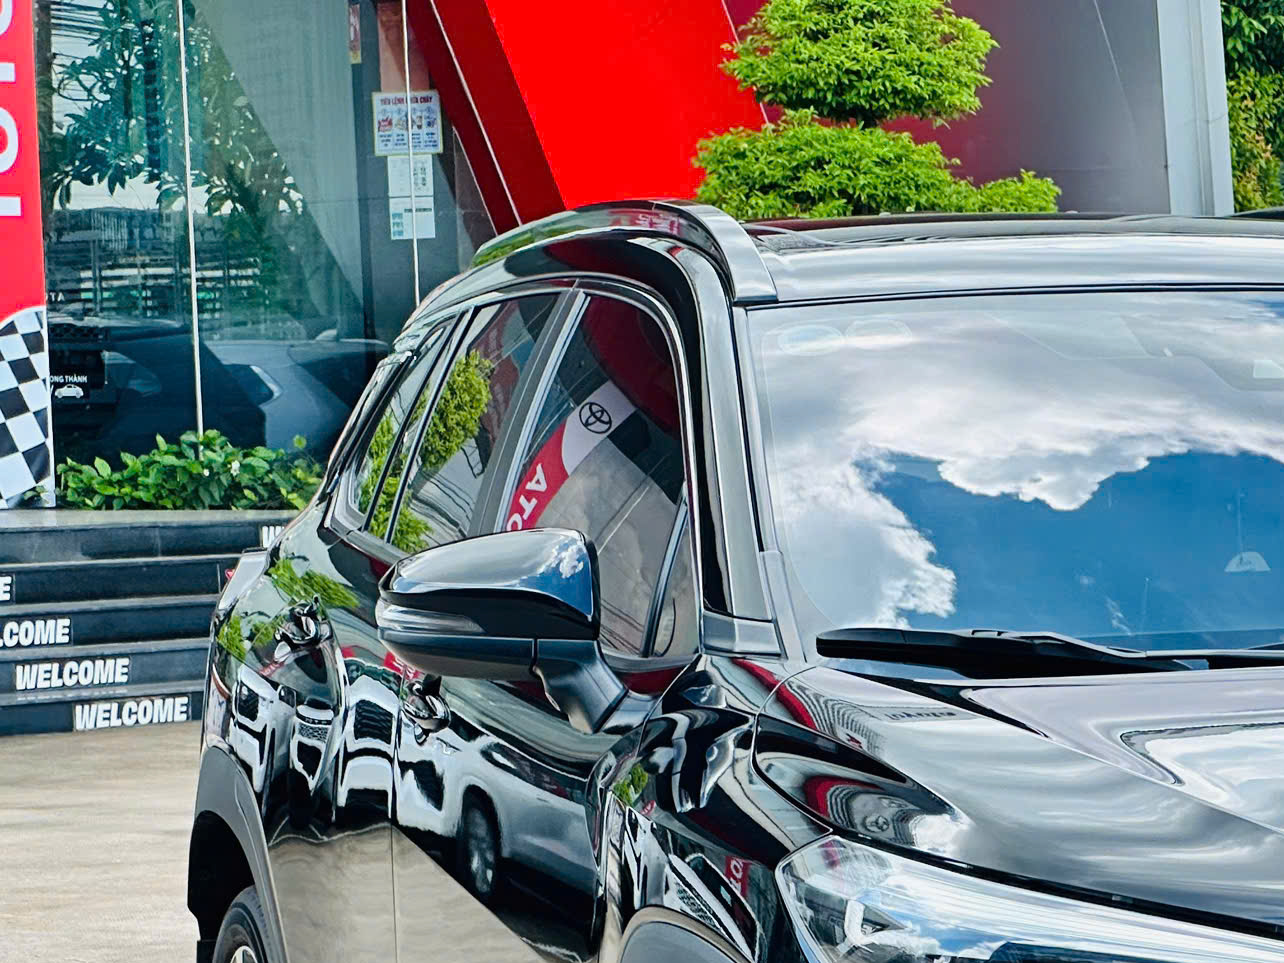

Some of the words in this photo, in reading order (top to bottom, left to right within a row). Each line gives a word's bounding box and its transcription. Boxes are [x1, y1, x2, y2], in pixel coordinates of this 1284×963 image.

[50, 375, 64, 383] ONG
[0, 618, 71, 648] COME
[15, 657, 130, 691] WELCOME
[74, 696, 189, 732] WELCOME
